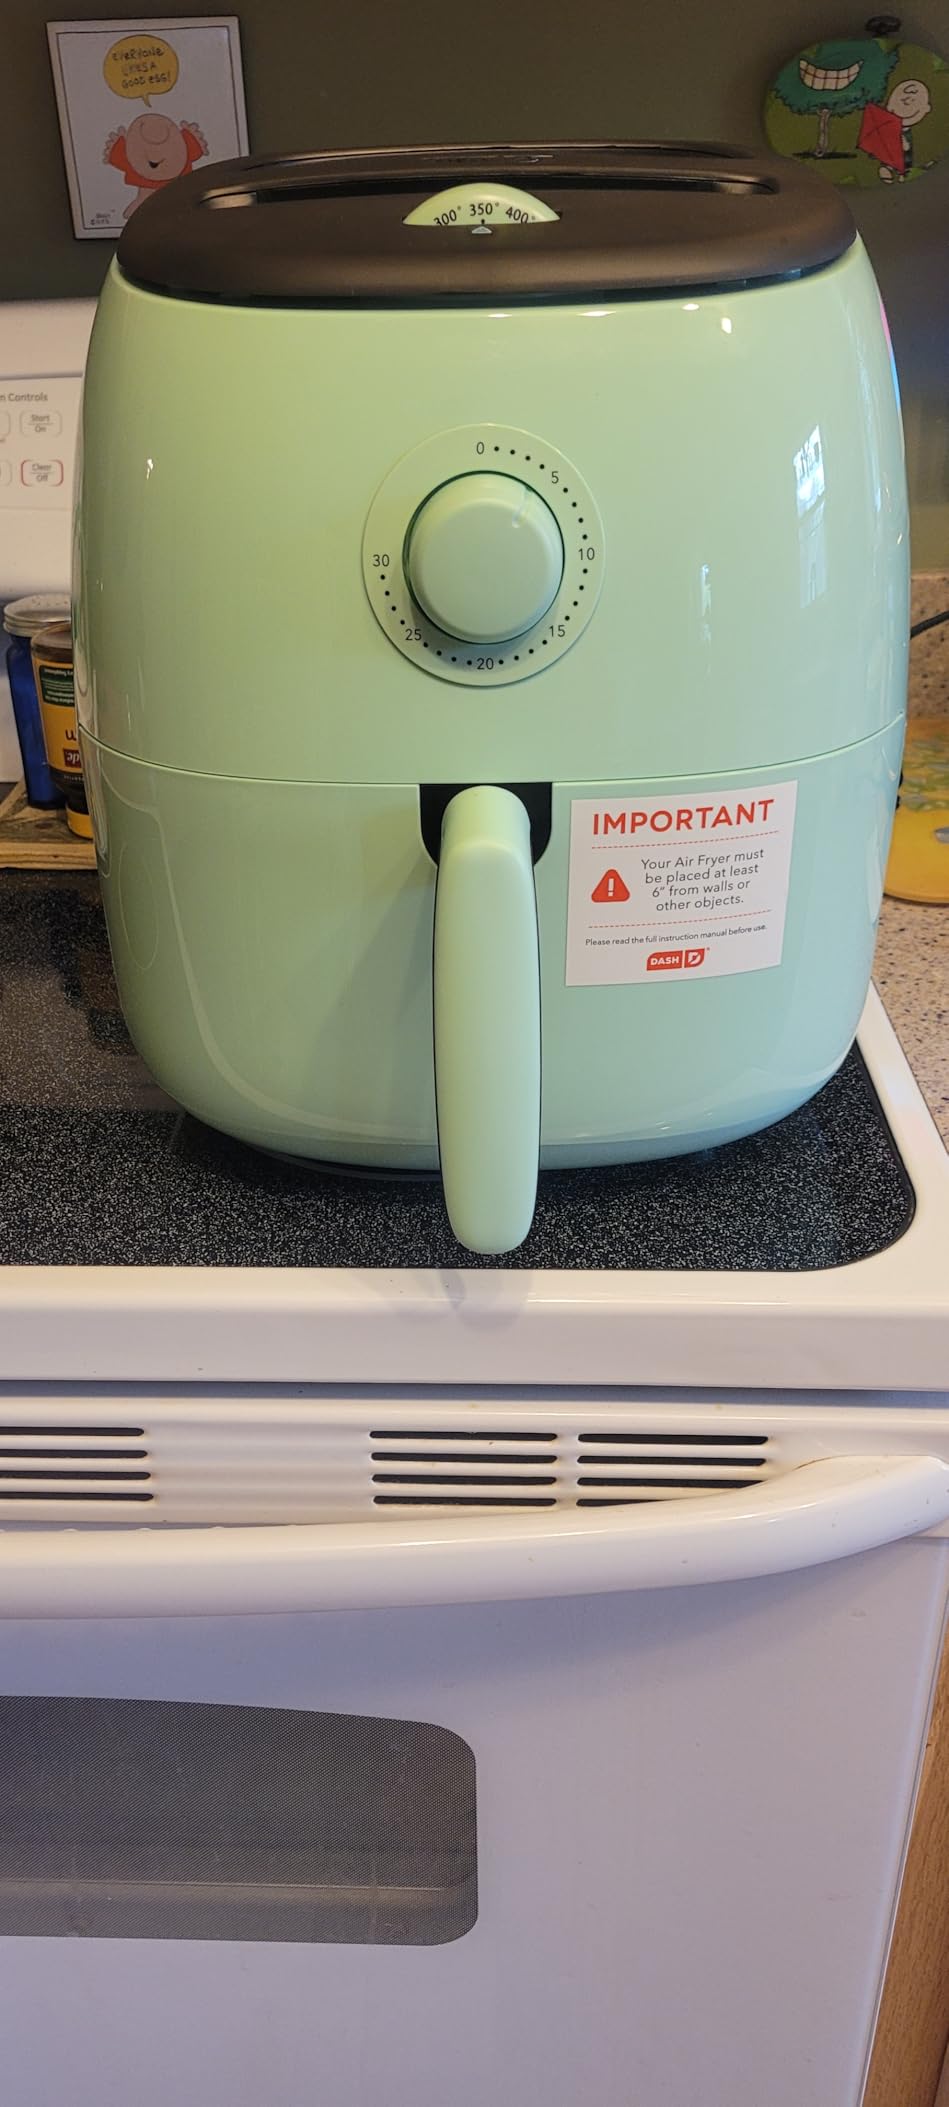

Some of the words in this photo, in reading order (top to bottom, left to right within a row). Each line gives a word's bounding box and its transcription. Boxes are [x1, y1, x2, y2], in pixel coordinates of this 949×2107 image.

[469, 202, 500, 217] 350°
[505, 206, 536, 224] 400°
[8, 392, 49, 402] Controls
[31, 414, 50, 422] Start
[34, 425, 47, 433] On
[476, 441, 485, 455] 0
[551, 470, 560, 484] 5
[372, 554, 390, 567] 30
[578, 547, 595, 561] 10
[405, 628, 422, 641] 25
[549, 624, 566, 638] 15
[476, 657, 494, 670] 20
[592, 798, 775, 836] IMPORTANT
[641, 858, 671, 870] Your
[674, 856, 694, 868] Air
[698, 854, 731, 868] Fryer
[734, 849, 764, 862] must
[645, 872, 662, 884] be
[666, 868, 710, 885] placed
[714, 868, 726, 879] at
[730, 864, 758, 876] least
[669, 885, 699, 896] from
[703, 880, 734, 893] walls
[737, 880, 751, 890] or
[656, 900, 691, 912] other
[694, 895, 744, 910] objects.
[585, 938, 611, 946] Please
[612, 937, 630, 945] read
[645, 935, 657, 943] full
[658, 933, 699, 942] instruction
[700, 929, 727, 939] manual
[728, 926, 752, 936] before
[753, 924, 767, 932] use.
[650, 955, 680, 966] DASH
